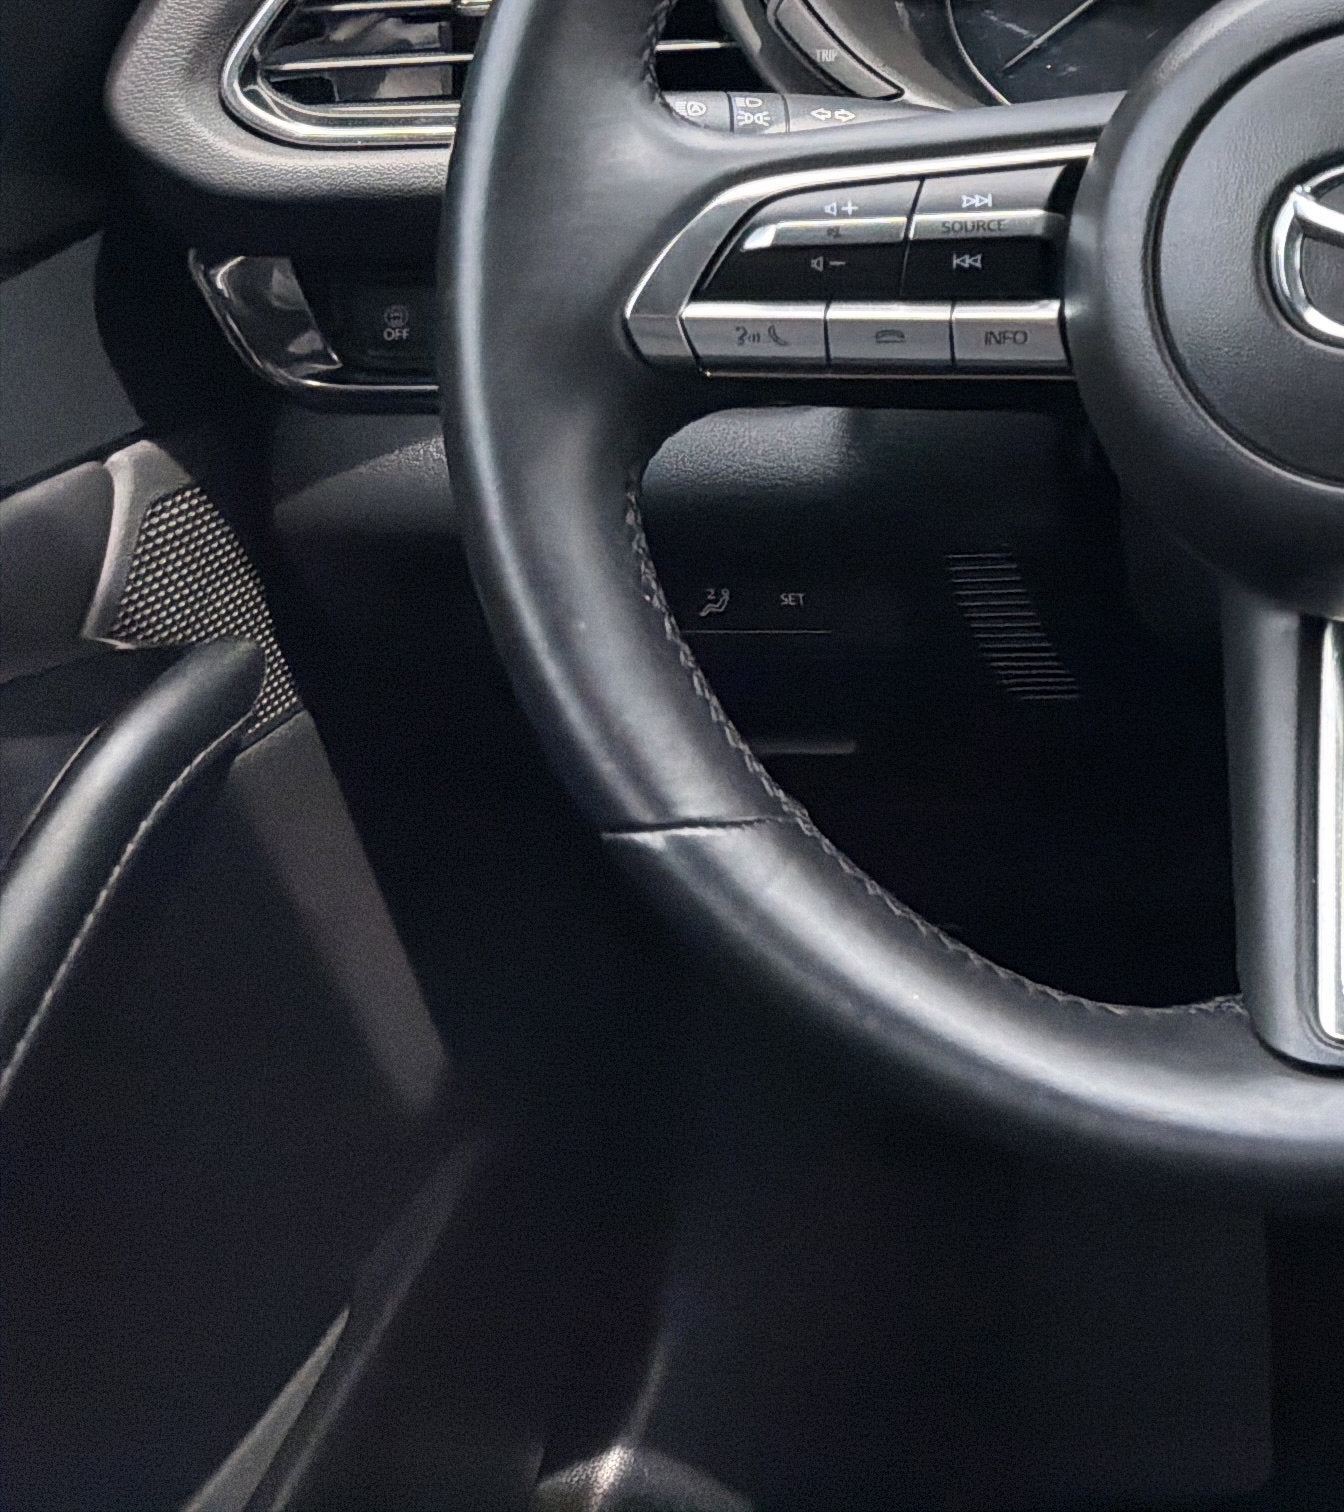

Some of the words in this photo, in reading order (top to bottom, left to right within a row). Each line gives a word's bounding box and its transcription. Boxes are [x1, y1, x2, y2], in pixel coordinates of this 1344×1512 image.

[941, 218, 1008, 234] SOURCE
[383, 326, 410, 341] OFF
[984, 330, 1029, 347] INFO
[779, 592, 806, 607] SET
